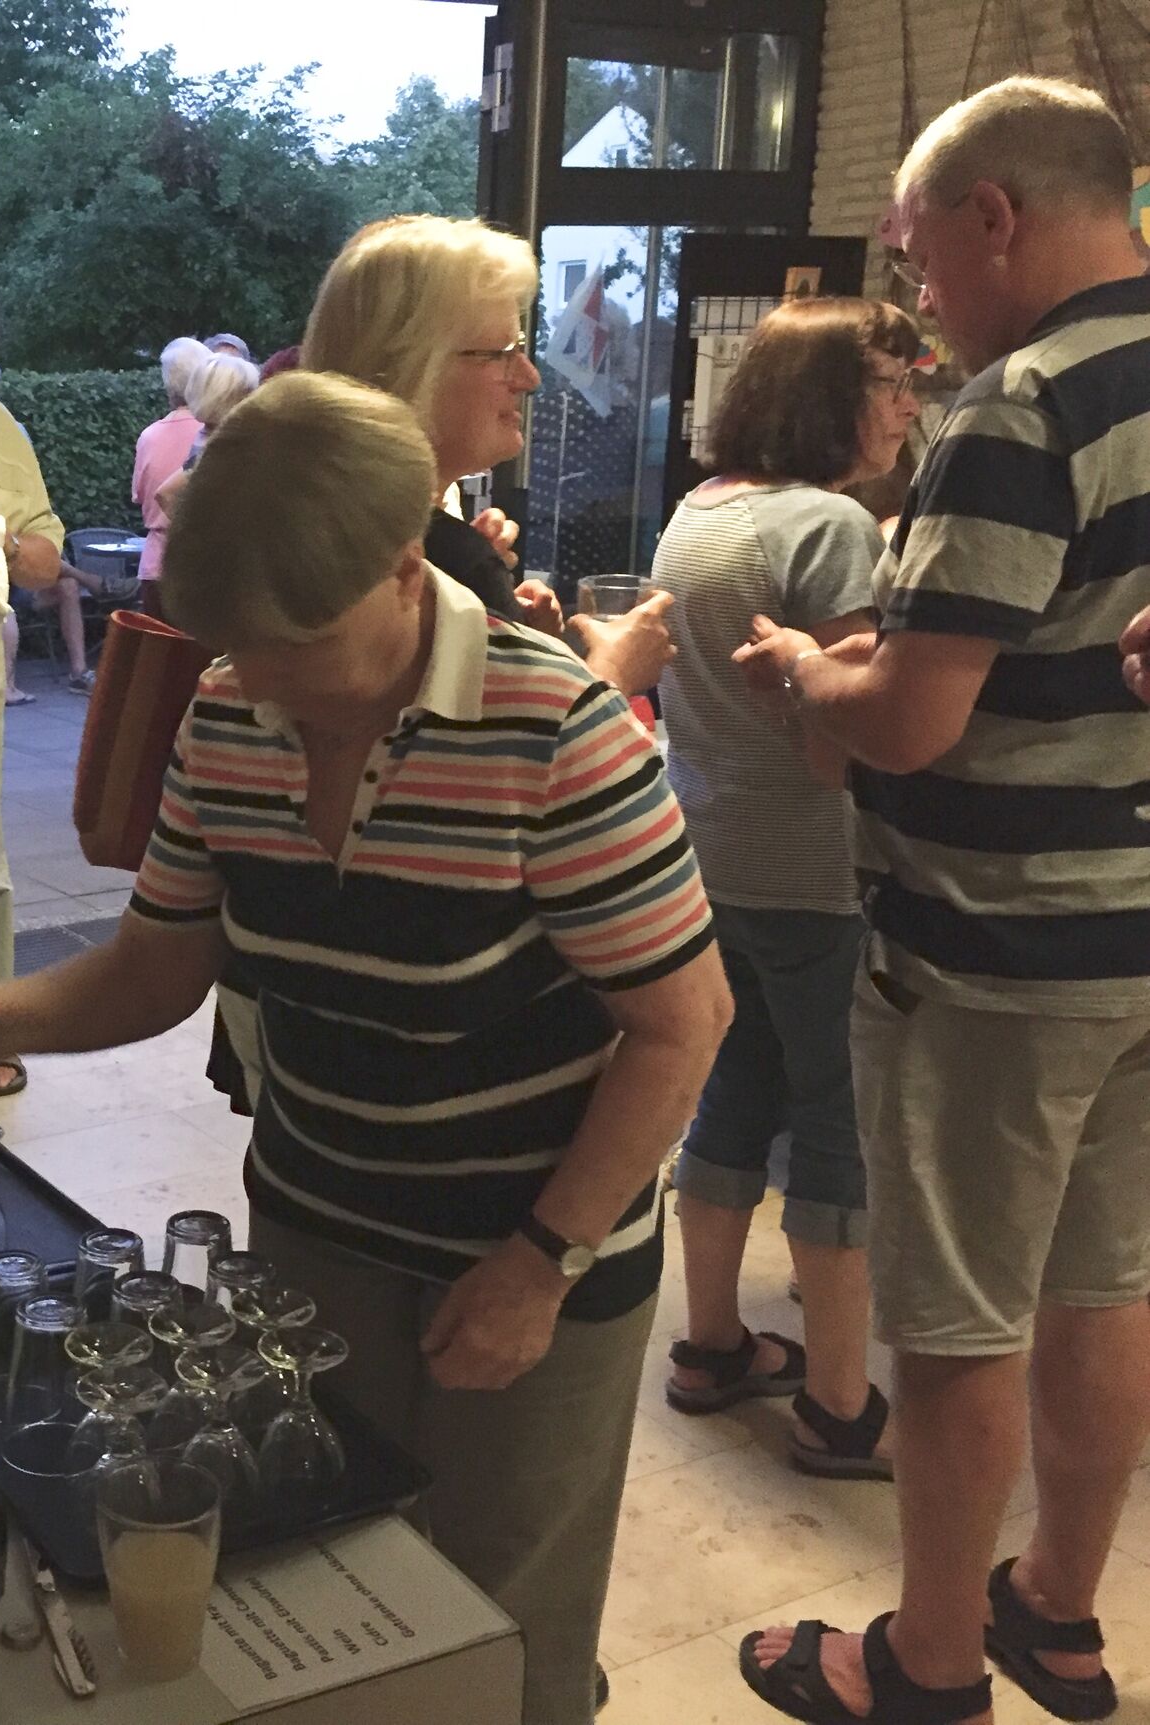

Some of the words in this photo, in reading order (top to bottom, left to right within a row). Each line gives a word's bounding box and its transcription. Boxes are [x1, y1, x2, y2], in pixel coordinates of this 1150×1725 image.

[244, 1576, 290, 1615] Eiswürfel
[345, 1573, 371, 1596] ohne
[218, 1620, 239, 1637] mit
[246, 1611, 266, 1628] mit
[286, 1617, 306, 1633] mit
[369, 1597, 415, 1638] Getränke
[304, 1634, 334, 1662] Pastis
[333, 1628, 362, 1656] Wein
[360, 1622, 388, 1646] Cidre
[234, 1638, 277, 1680] Baguette
[263, 1629, 306, 1671] Baguette
